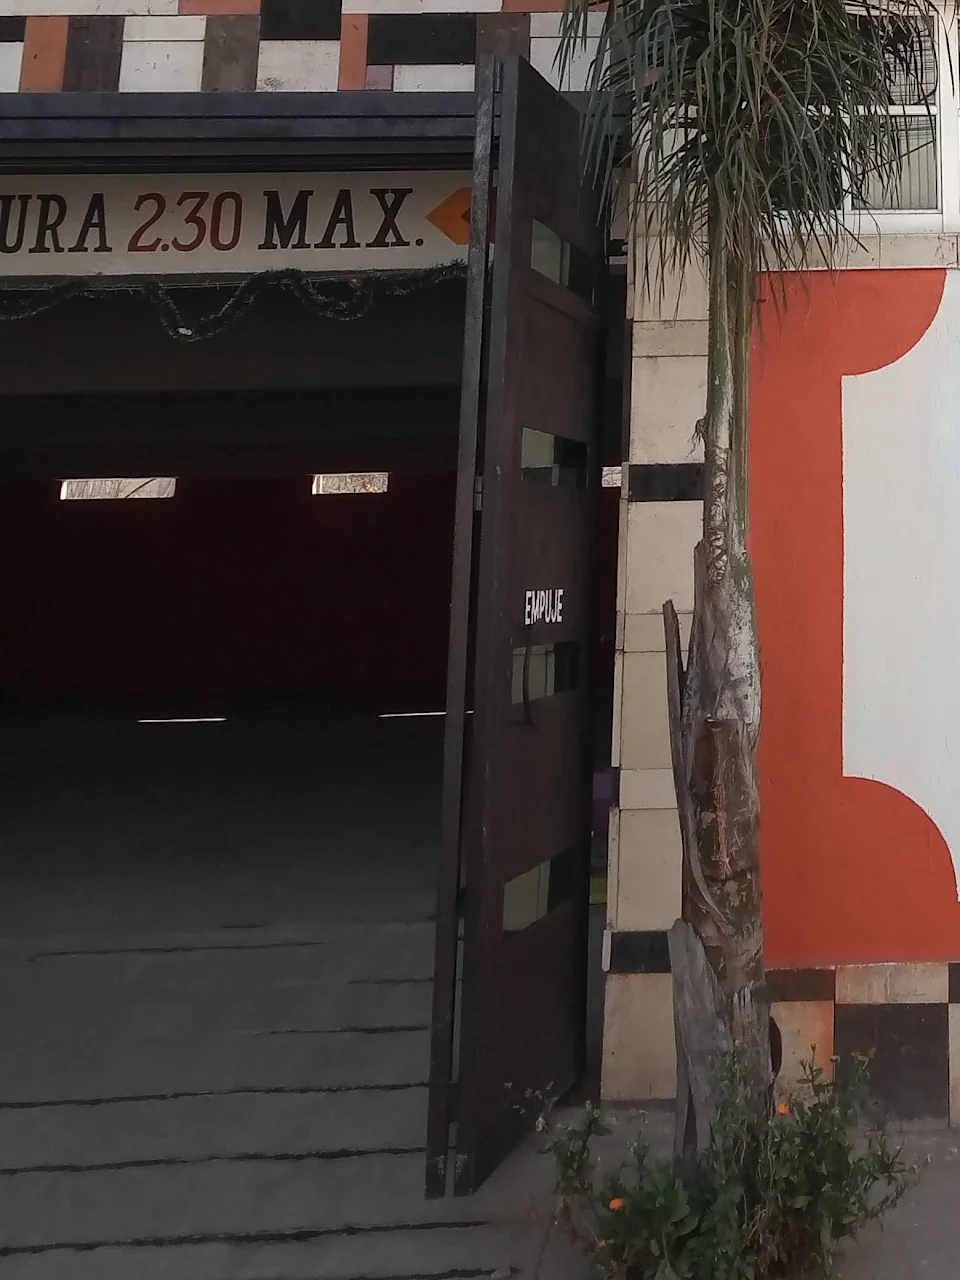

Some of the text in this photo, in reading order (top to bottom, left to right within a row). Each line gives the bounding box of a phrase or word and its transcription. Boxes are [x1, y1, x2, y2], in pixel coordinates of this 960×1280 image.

[0, 187, 425, 254] URA 2.30 MAX.
[524, 588, 564, 626] EMPUJE
